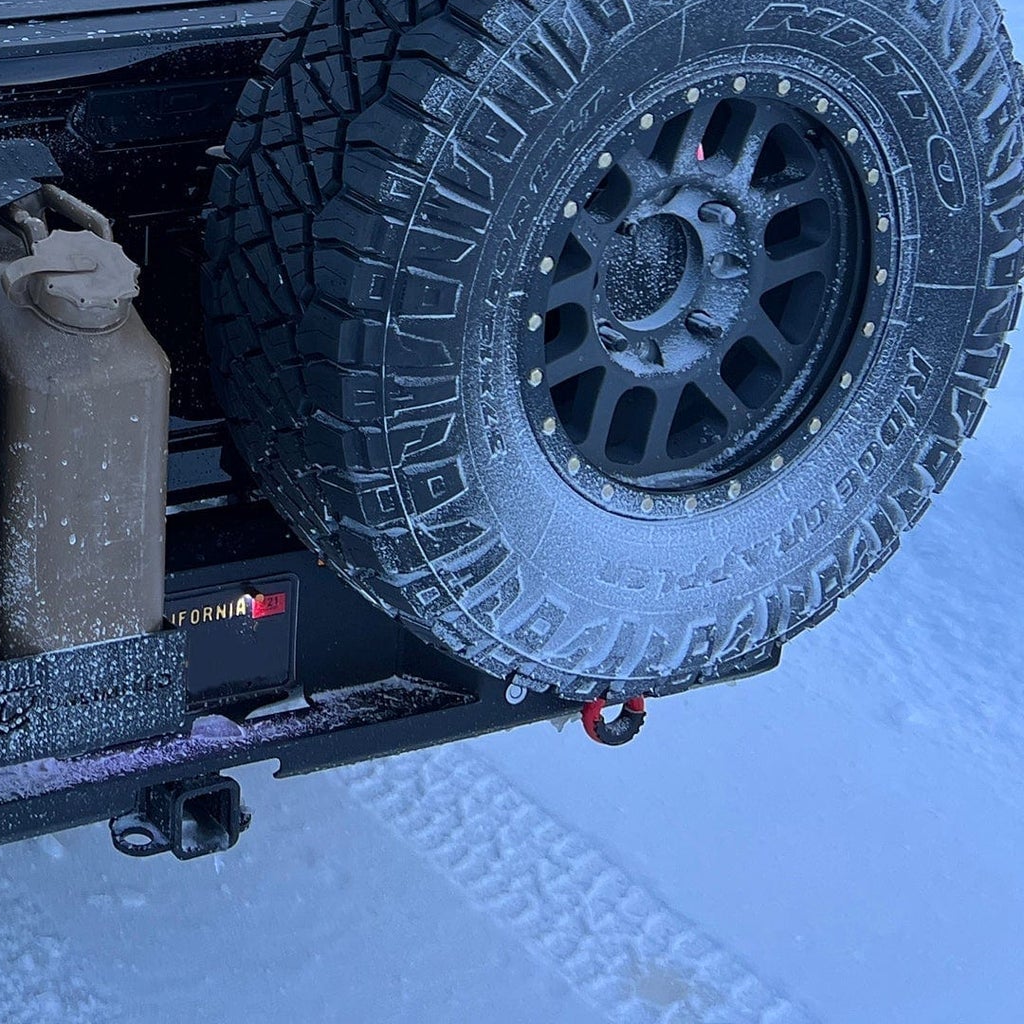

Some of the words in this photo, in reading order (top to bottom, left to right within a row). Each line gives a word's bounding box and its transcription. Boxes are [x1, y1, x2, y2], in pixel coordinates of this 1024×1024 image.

[745, 3, 966, 210] NITTO
[830, 349, 935, 507] RIDGE
[171, 596, 246, 626] IFORNIA
